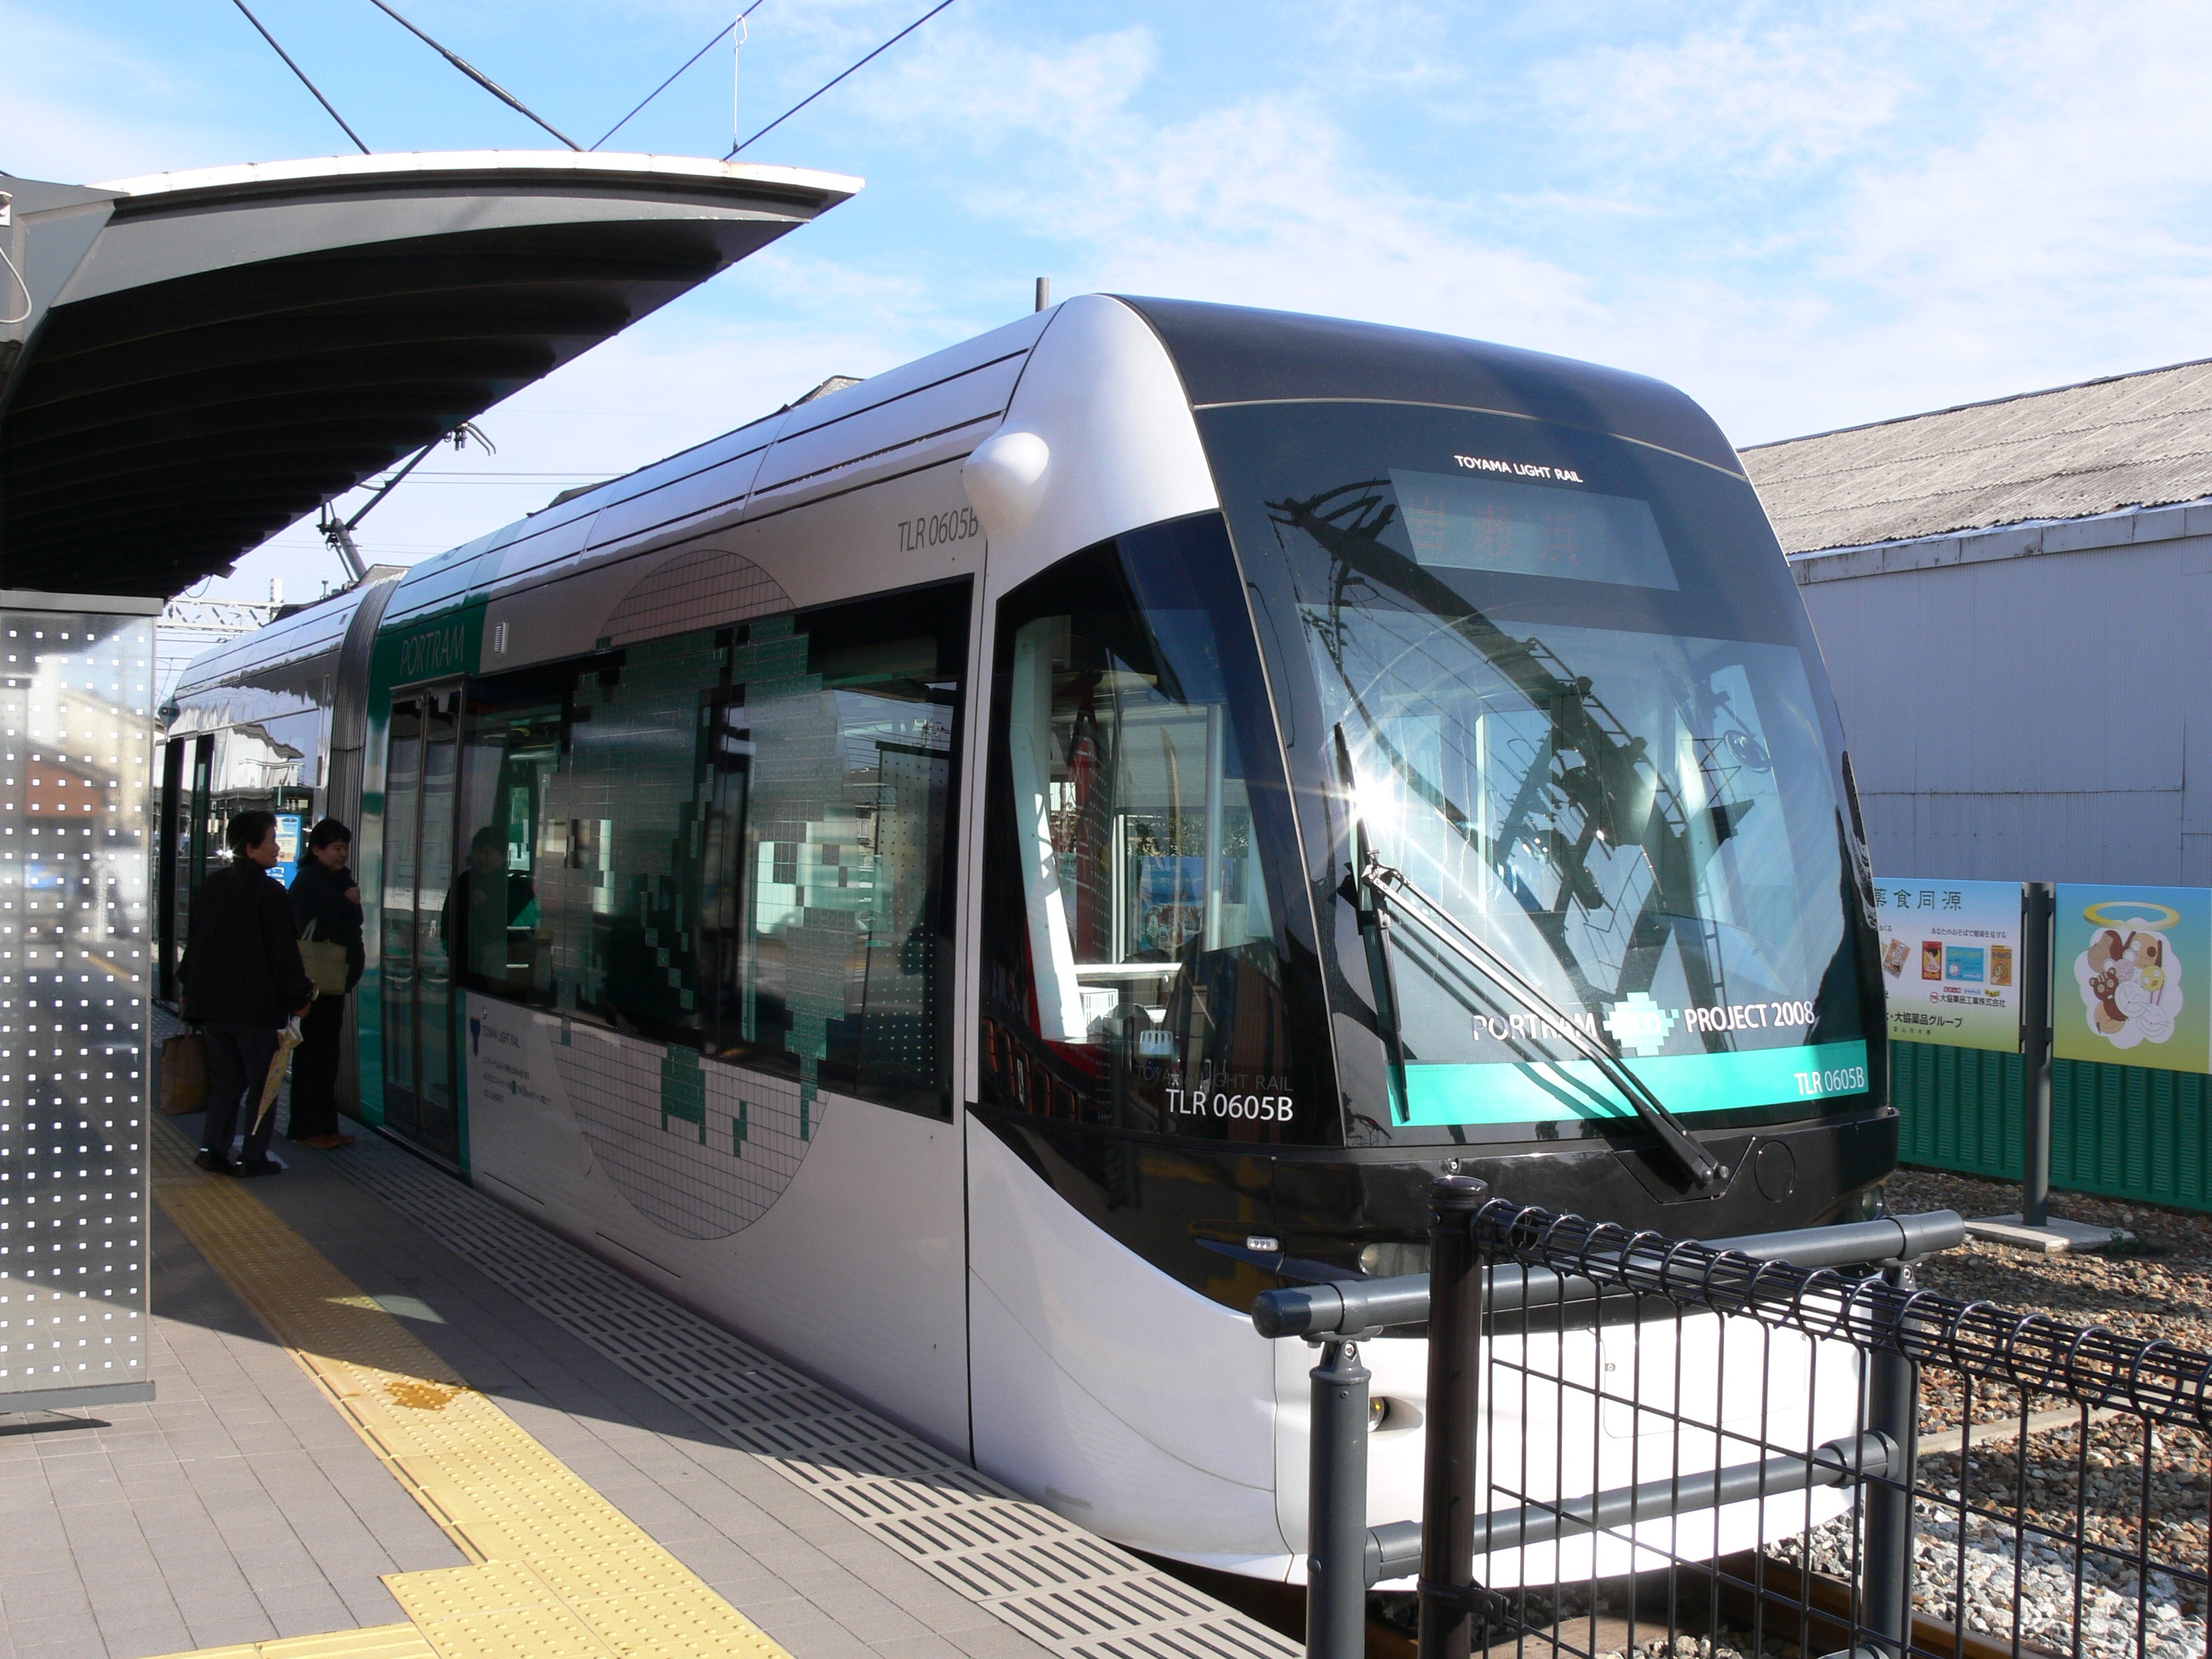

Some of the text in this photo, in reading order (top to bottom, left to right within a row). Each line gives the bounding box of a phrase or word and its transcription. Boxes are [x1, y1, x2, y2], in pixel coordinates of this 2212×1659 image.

[1454, 455, 1584, 483] TOYAMA LIGHT RAIL
[898, 506, 979, 553] TLR 0605B
[400, 622, 466, 676] PORTRAM
[1685, 1003, 1768, 1033] PROJECT
[1771, 1000, 1816, 1028] 2008
[1940, 994, 2006, 1008] 大協薬品工業株式会社
[1205, 1071, 1250, 1089] IGHT
[1255, 1075, 1294, 1092] RAIL
[1794, 1066, 1865, 1096] TLR 0605B
[1165, 1088, 1294, 1122] TLR 0605B
